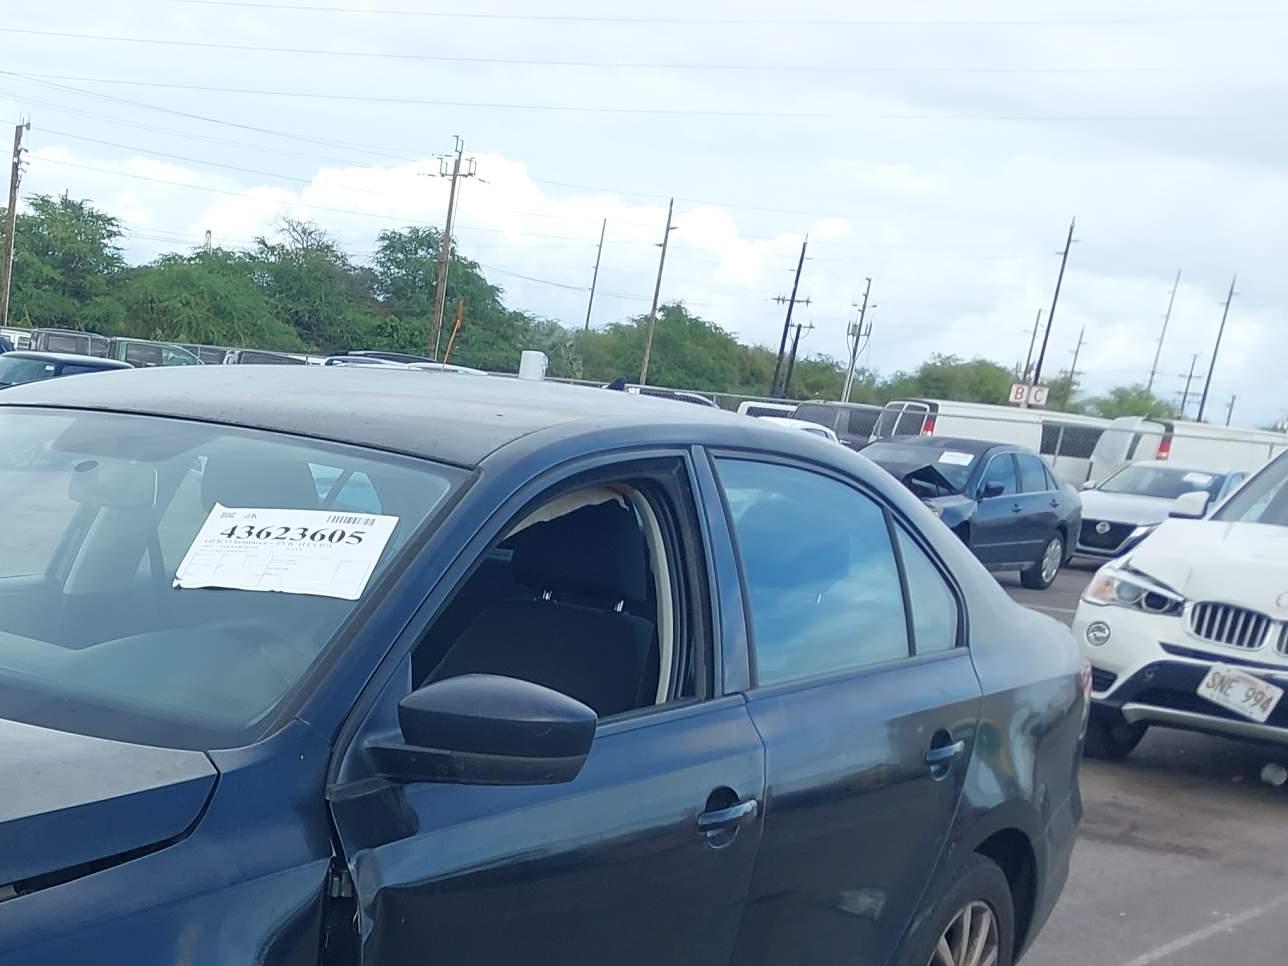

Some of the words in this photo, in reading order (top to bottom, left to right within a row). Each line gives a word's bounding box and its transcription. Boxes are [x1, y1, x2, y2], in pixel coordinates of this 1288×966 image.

[1014, 386, 1025, 400] B
[1034, 388, 1045, 402] C
[220, 524, 366, 545] 43623605
[1241, 687, 1274, 713] 994
